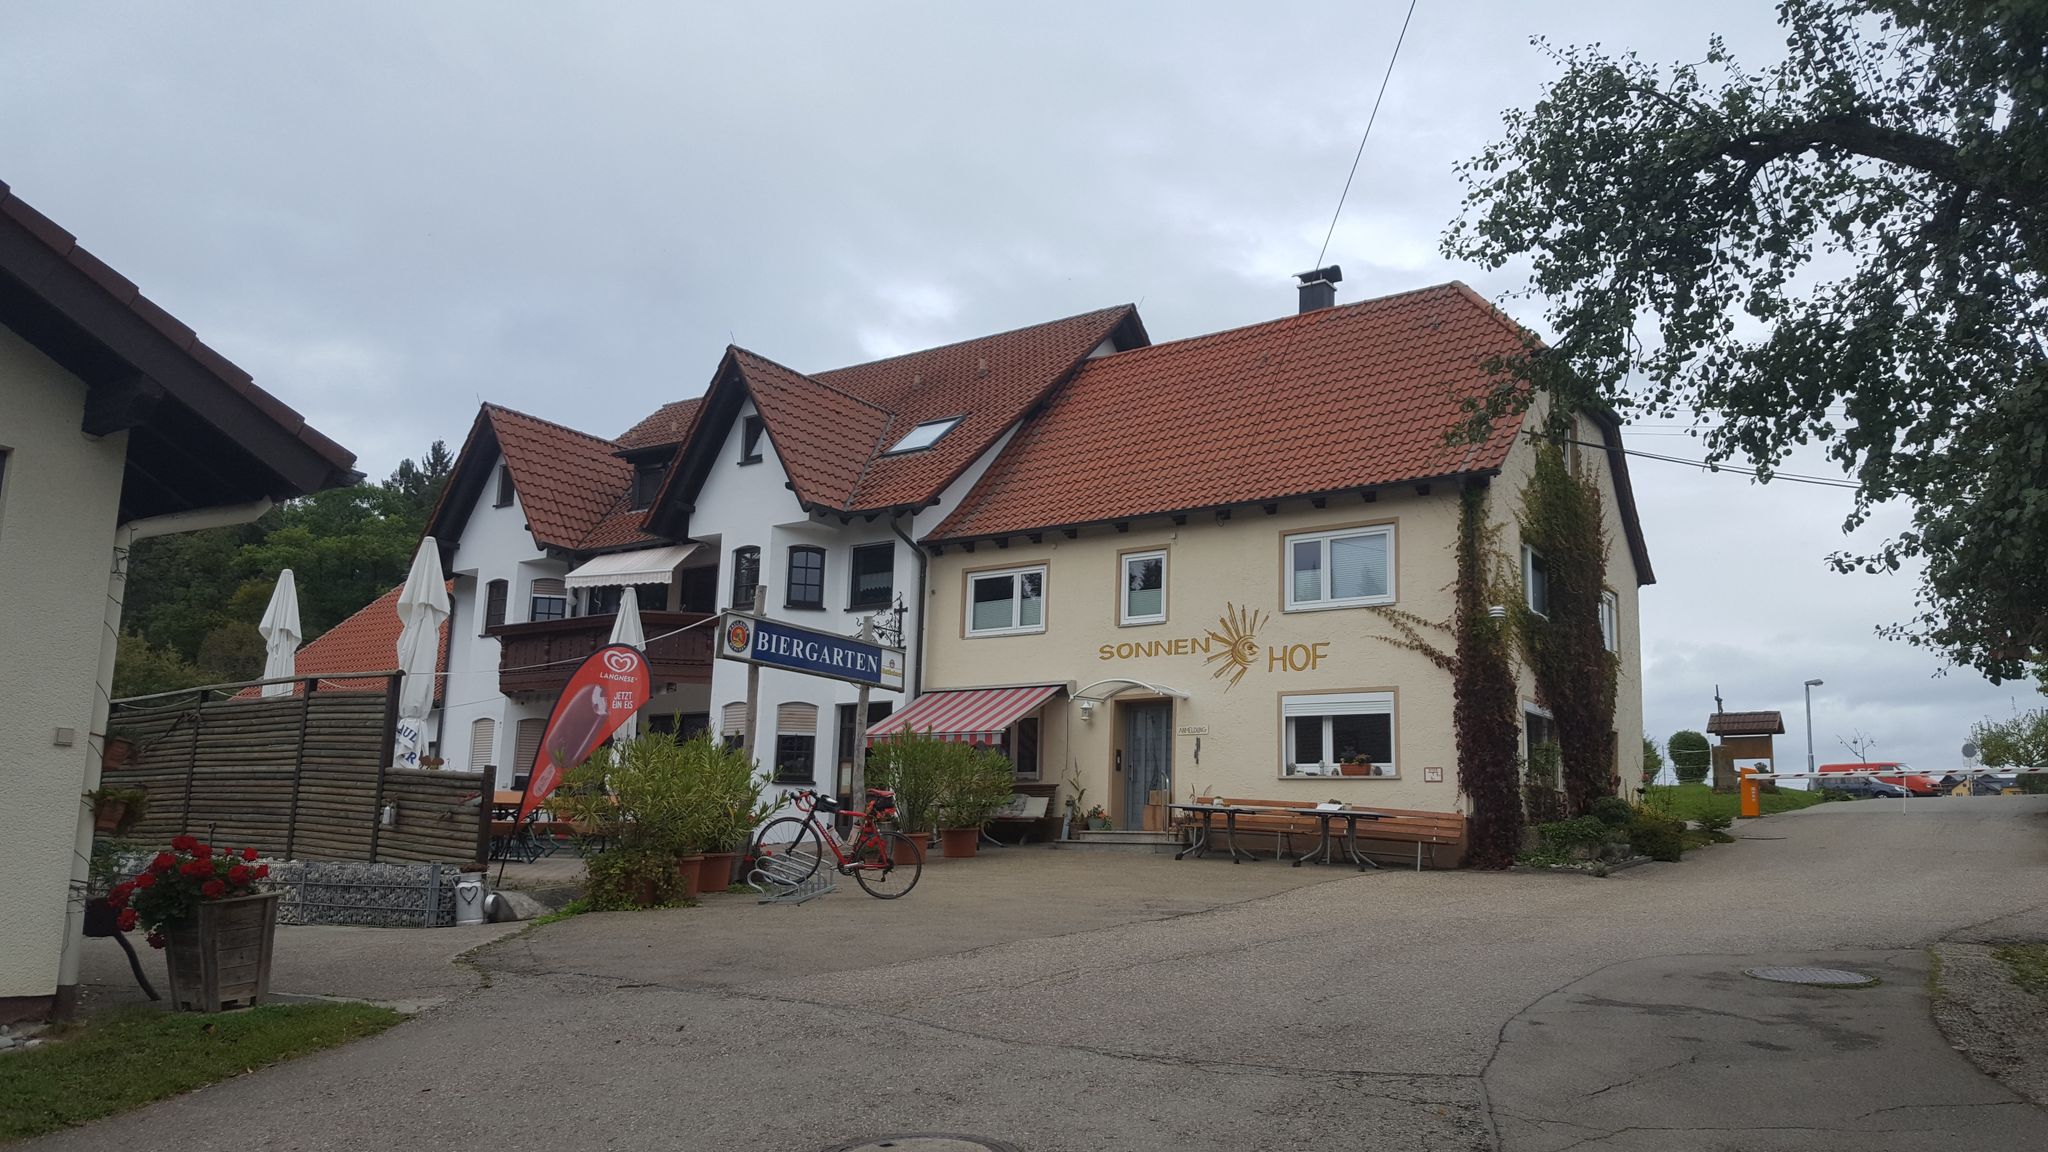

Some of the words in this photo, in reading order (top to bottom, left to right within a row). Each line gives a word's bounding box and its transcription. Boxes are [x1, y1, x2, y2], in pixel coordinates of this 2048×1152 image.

[756, 631, 879, 673] BIERGARTEN
[1099, 637, 1211, 661] SONNEN
[1268, 641, 1330, 673] HOF
[600, 672, 636, 682] LANGNESE
[614, 692, 632, 700] JETZT
[612, 700, 622, 709] EIN
[624, 701, 633, 709] EIS
